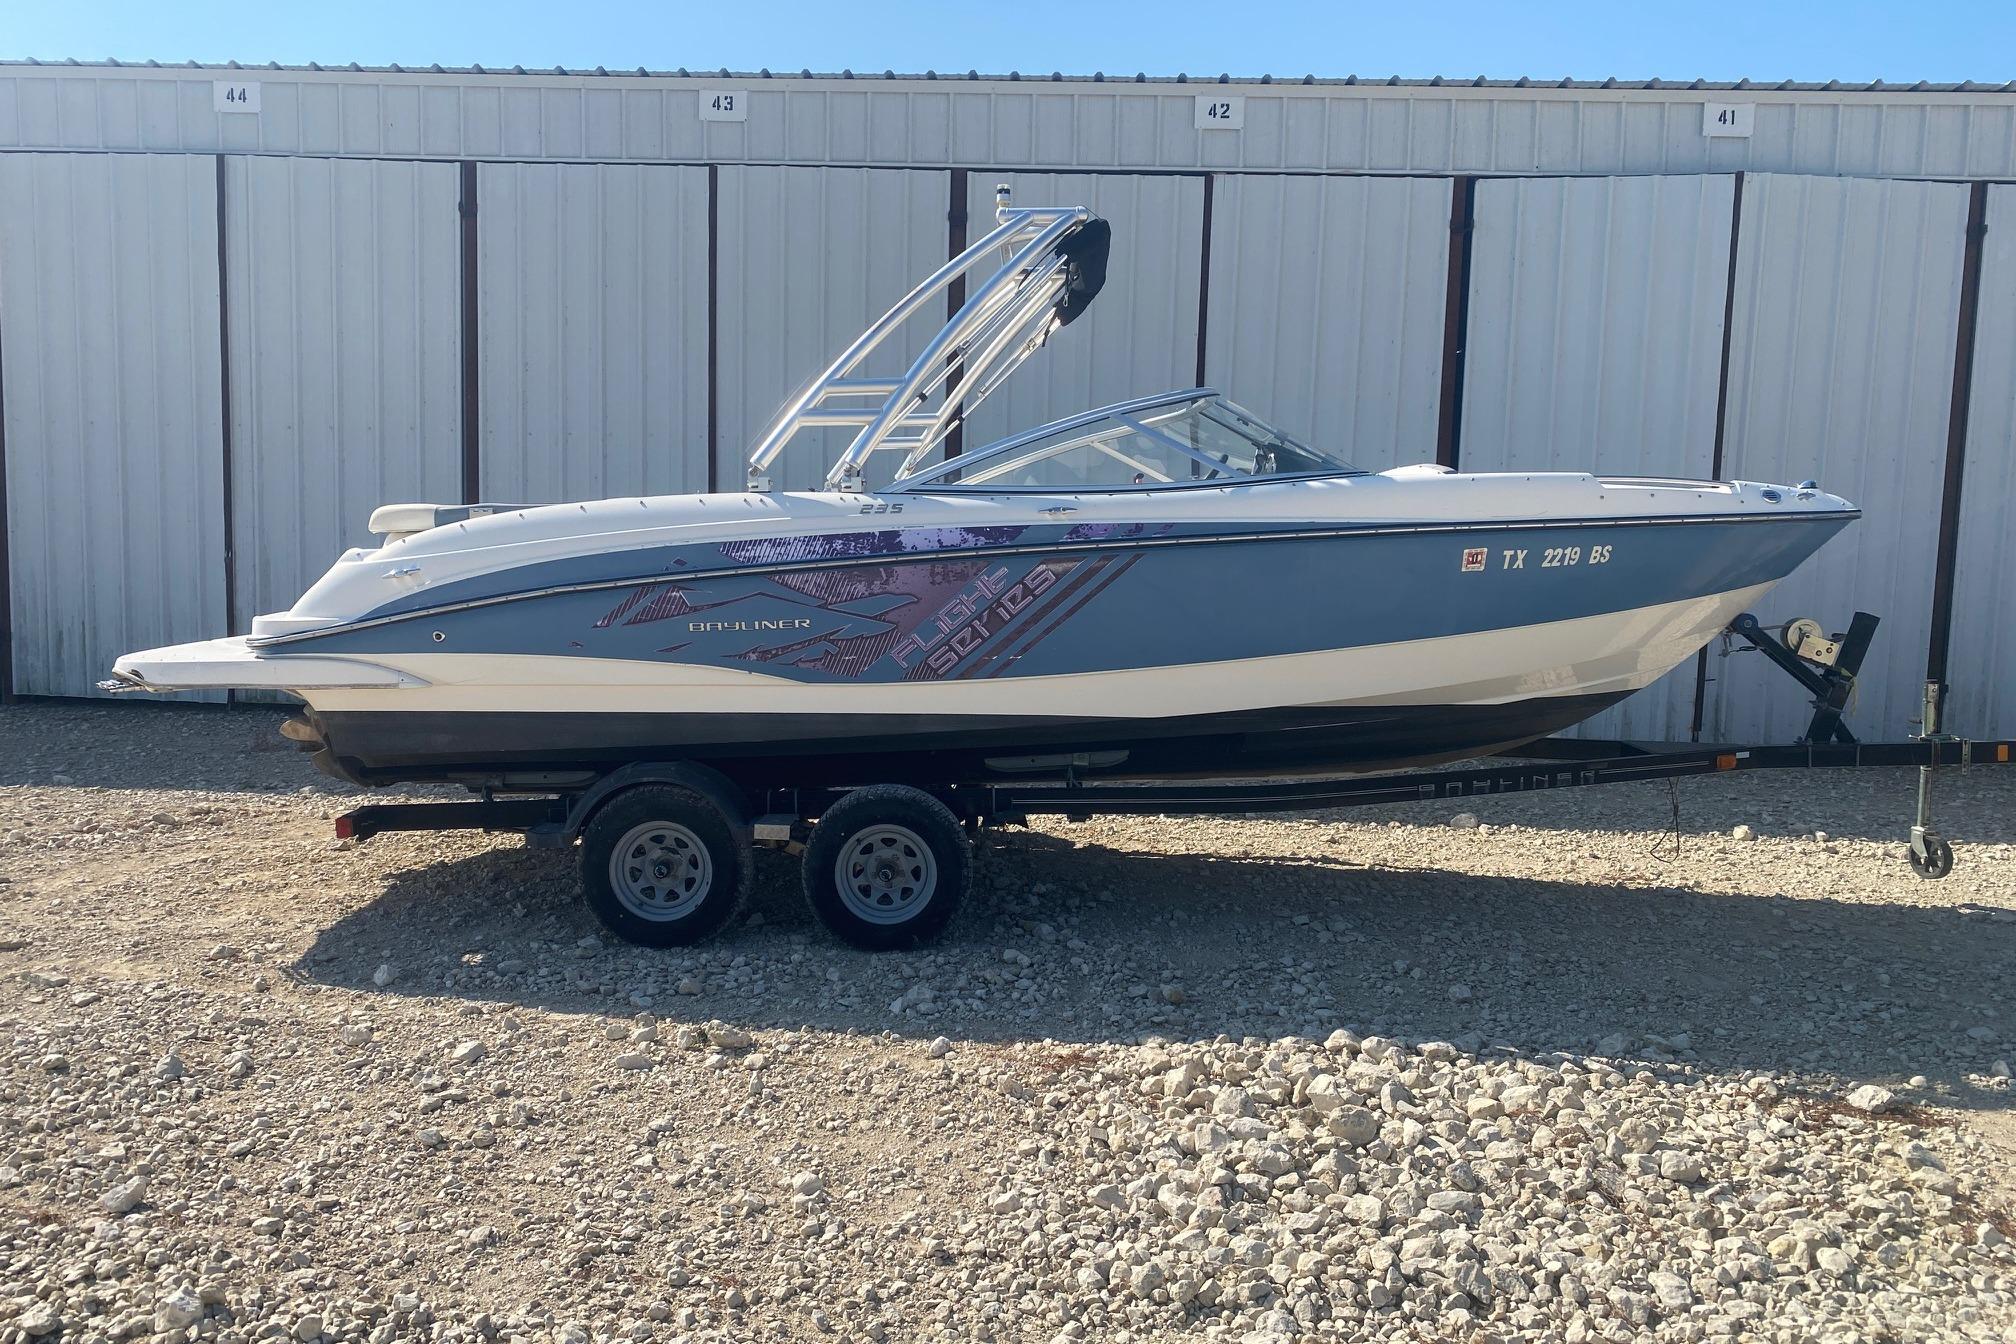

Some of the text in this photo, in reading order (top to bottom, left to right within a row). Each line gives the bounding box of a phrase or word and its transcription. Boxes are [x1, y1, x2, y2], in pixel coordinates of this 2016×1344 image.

[226, 87, 247, 103] 44
[712, 95, 733, 111] 43
[1208, 103, 1230, 119] 42
[1718, 109, 1735, 125] 41
[859, 503, 904, 514] 235
[1503, 549, 1528, 570] TX
[1541, 546, 1581, 568] 2219
[1588, 544, 1613, 565] BS
[688, 618, 811, 632] BAYLINER
